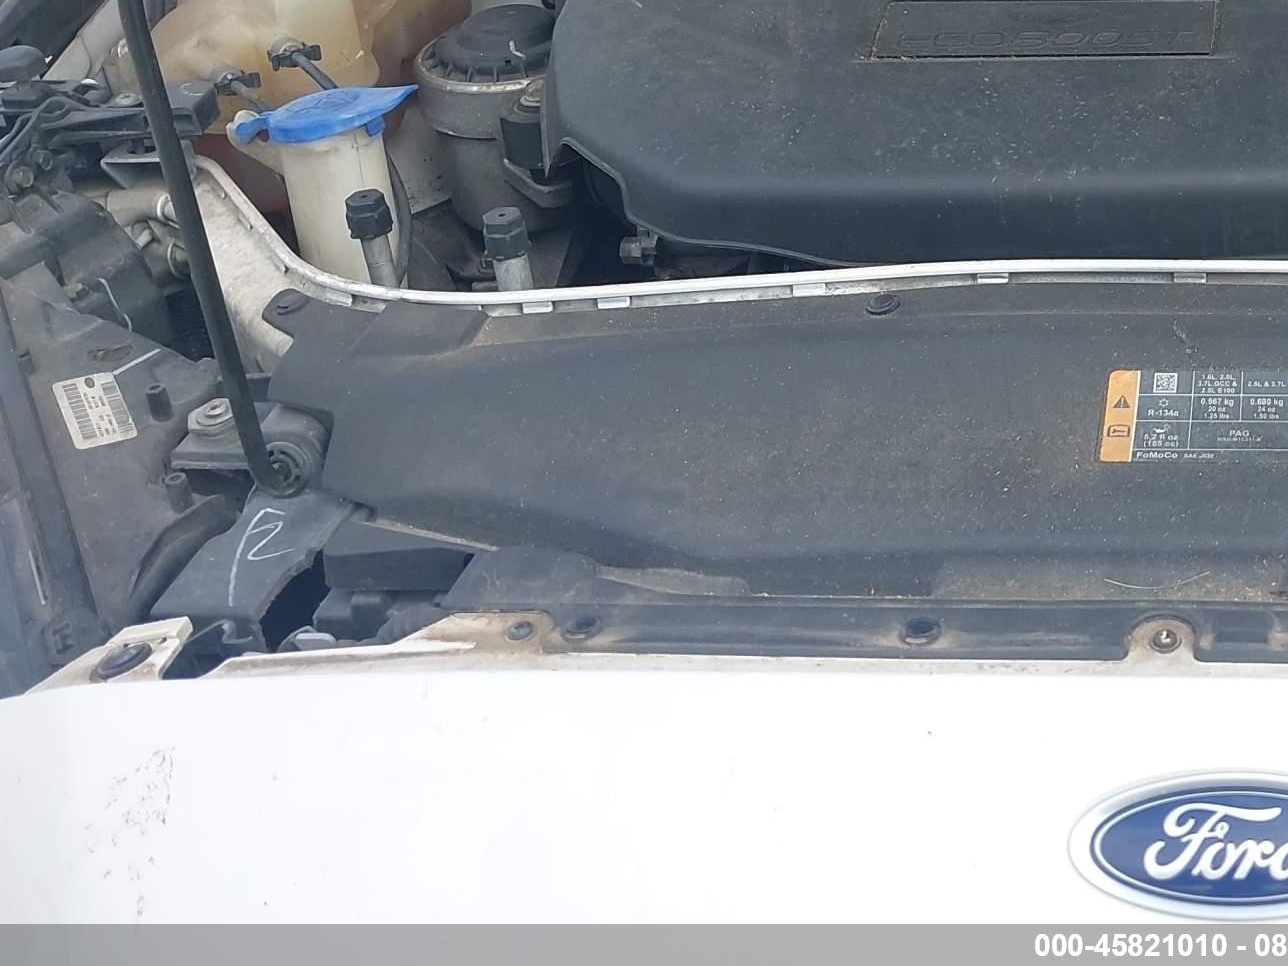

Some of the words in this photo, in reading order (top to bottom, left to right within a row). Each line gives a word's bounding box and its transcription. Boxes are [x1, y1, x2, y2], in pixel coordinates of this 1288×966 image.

[1224, 398, 1234, 407] kg
[1274, 398, 1284, 407] kg
[1148, 409, 1179, 417] R-134a
